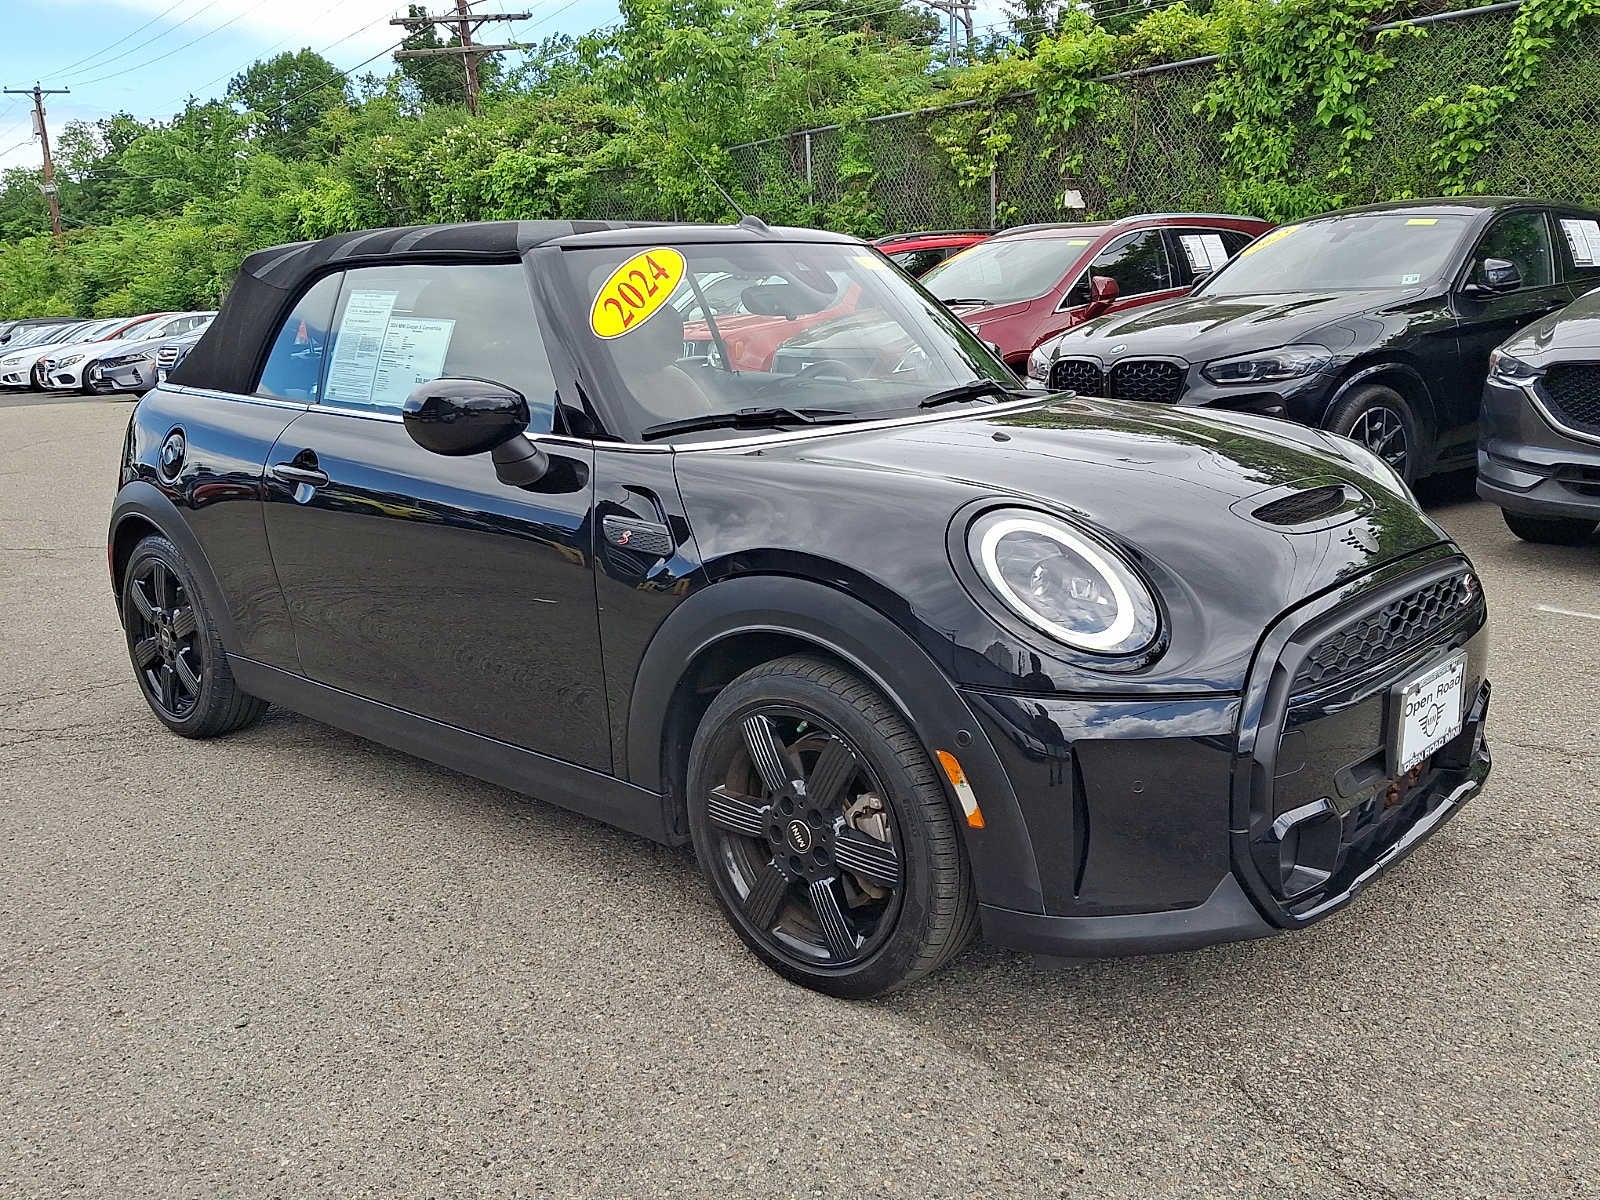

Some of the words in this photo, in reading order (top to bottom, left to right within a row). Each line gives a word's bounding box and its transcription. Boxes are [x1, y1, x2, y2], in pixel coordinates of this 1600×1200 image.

[604, 254, 670, 329] 2024
[1405, 692, 1433, 718] Open
[1436, 671, 1461, 699] Road
[1403, 752, 1424, 773] OPEN
[1424, 737, 1445, 759] ROAD
[791, 824, 807, 848] MINI
